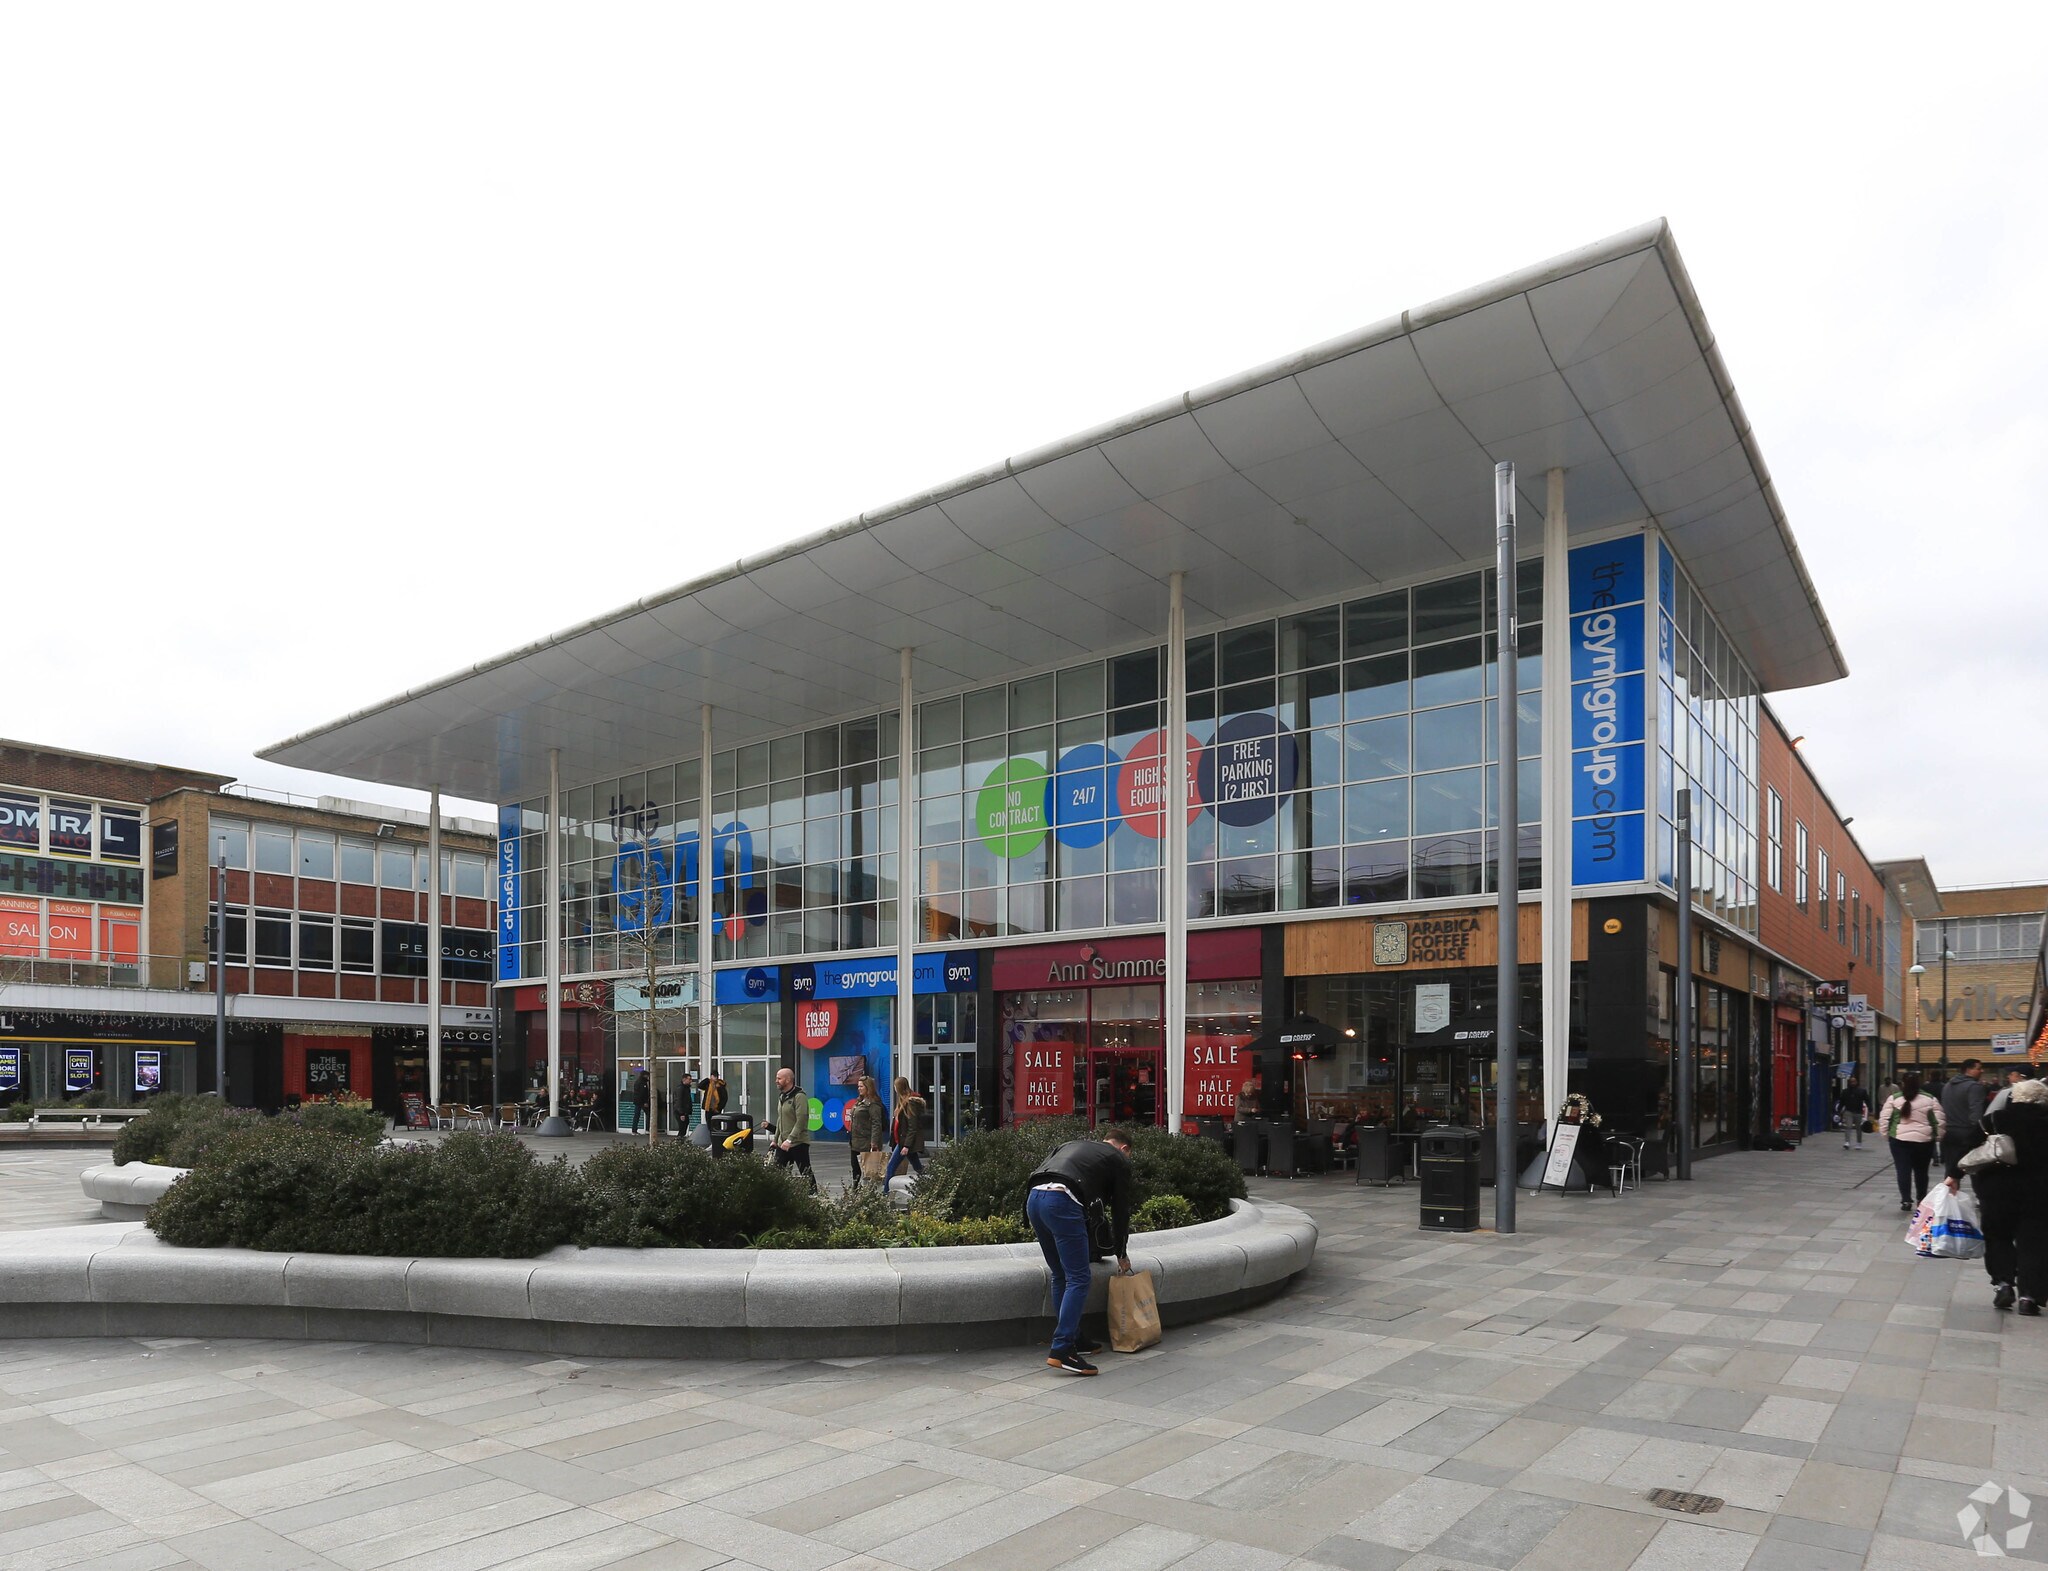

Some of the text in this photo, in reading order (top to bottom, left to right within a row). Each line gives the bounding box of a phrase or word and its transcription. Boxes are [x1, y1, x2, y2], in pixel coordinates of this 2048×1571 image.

[1583, 561, 1624, 862] thegymgroup.com
[1233, 740, 1261, 761] FREE
[1133, 767, 1159, 787] HIGH
[1221, 758, 1273, 782] PARKING
[1072, 786, 1097, 806] 24/7
[1241, 777, 1270, 800] HRS)
[1007, 791, 1021, 807] NO
[609, 793, 659, 842] the
[989, 806, 1040, 828] CONTRACT
[504, 815, 515, 969] thegymgroup.com
[55, 904, 85, 914] SALON
[9, 922, 77, 940] SALON
[1412, 918, 1480, 935] ARABICA
[1412, 932, 1469, 949] COFFEE
[1412, 947, 1466, 962] HOUSE
[949, 965, 970, 981] gym
[1047, 961, 1085, 982] Ann
[749, 978, 765, 989] gym
[794, 976, 813, 991] gym
[805, 1011, 830, 1028] £19.99
[811, 1028, 829, 1037] MONTH
[320, 1056, 336, 1064] THE
[1025, 1051, 1062, 1068] SALE
[1194, 1046, 1238, 1065] SALE
[310, 1063, 347, 1071] BIGGEST
[1029, 1082, 1057, 1093] HALF
[1200, 1080, 1232, 1093] HALF
[1027, 1095, 1058, 1107] PRICE
[1197, 1094, 1234, 1107] PRICE
